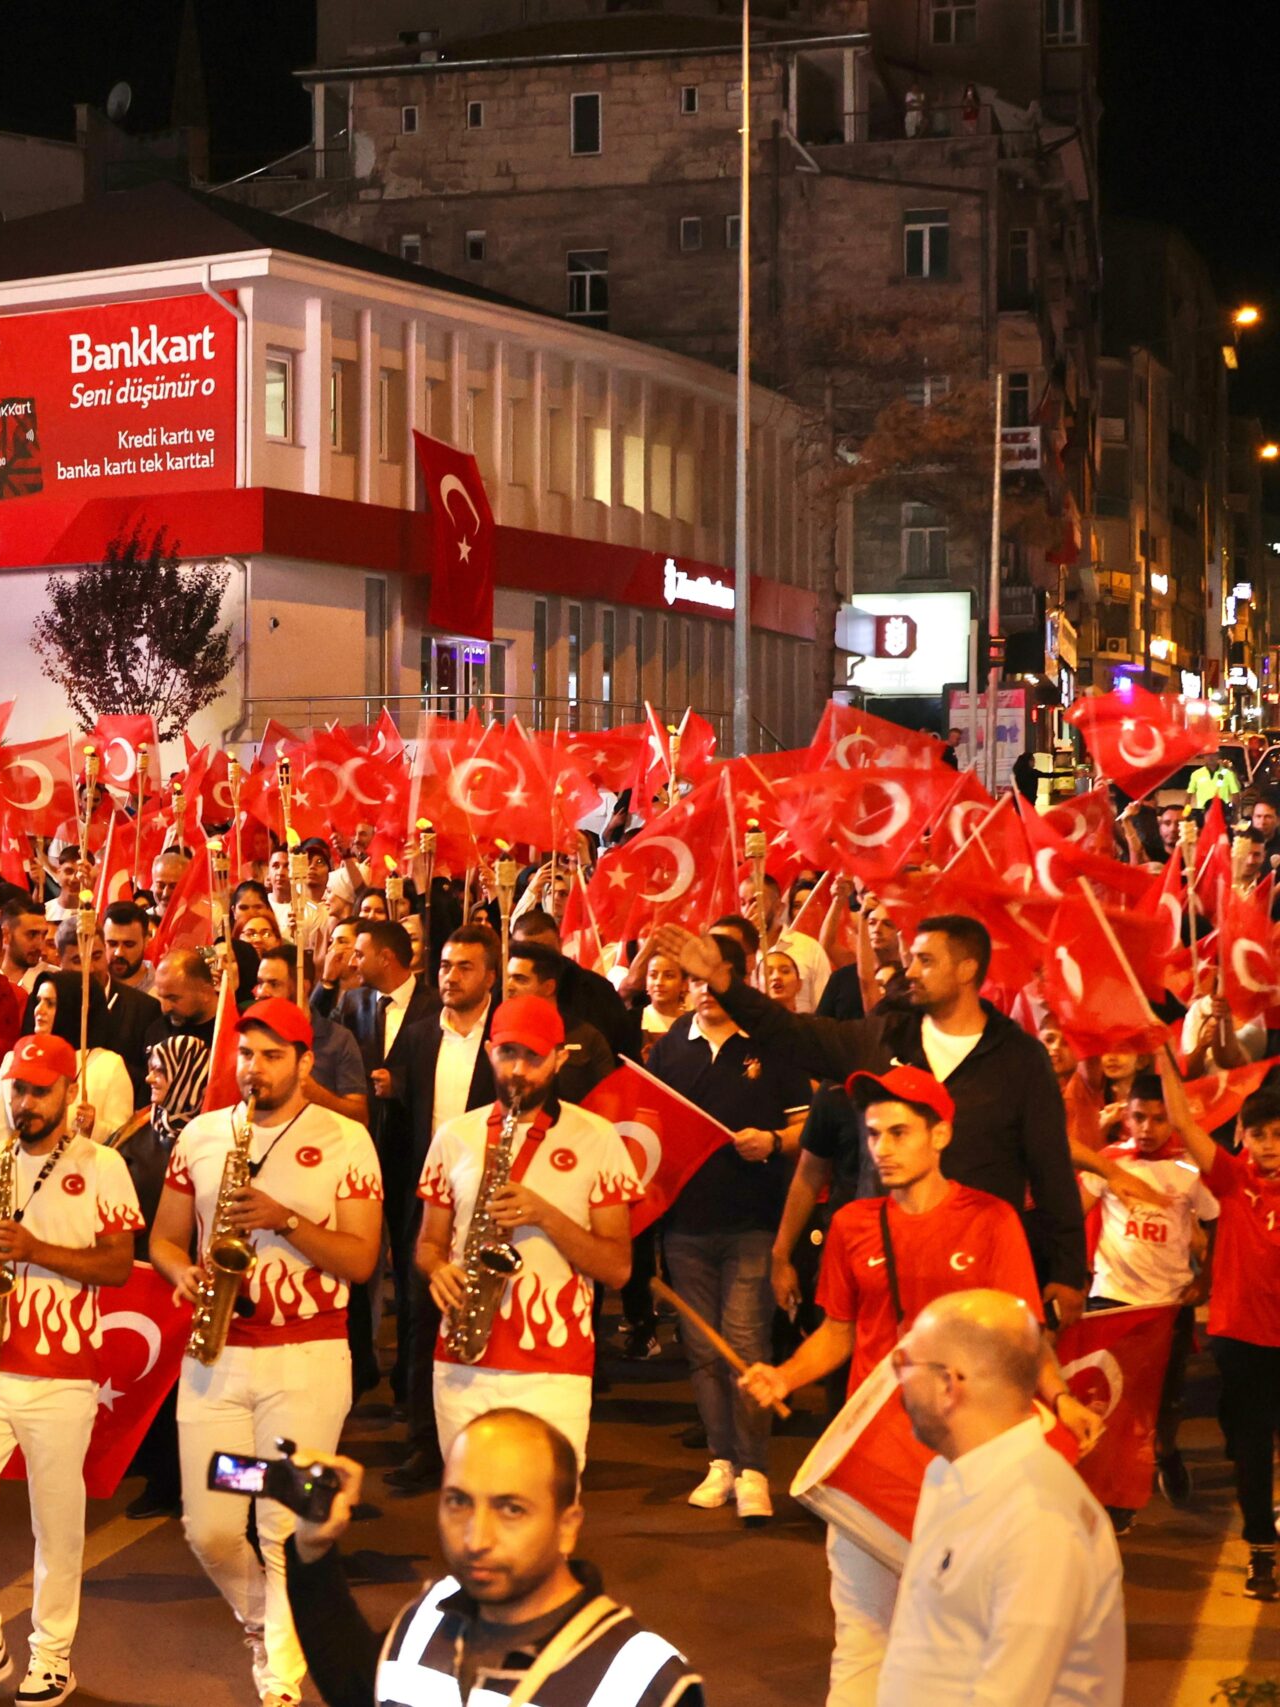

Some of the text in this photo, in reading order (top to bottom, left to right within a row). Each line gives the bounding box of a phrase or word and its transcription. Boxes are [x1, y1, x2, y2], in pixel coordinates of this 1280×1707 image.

[69, 324, 215, 373] Bankkart
[69, 373, 215, 409] Seni düşünür o
[118, 427, 215, 449] Kredi kartı ve
[57, 448, 215, 480] banka kartı tek kartta!
[1124, 1220, 1168, 1243] ARI
